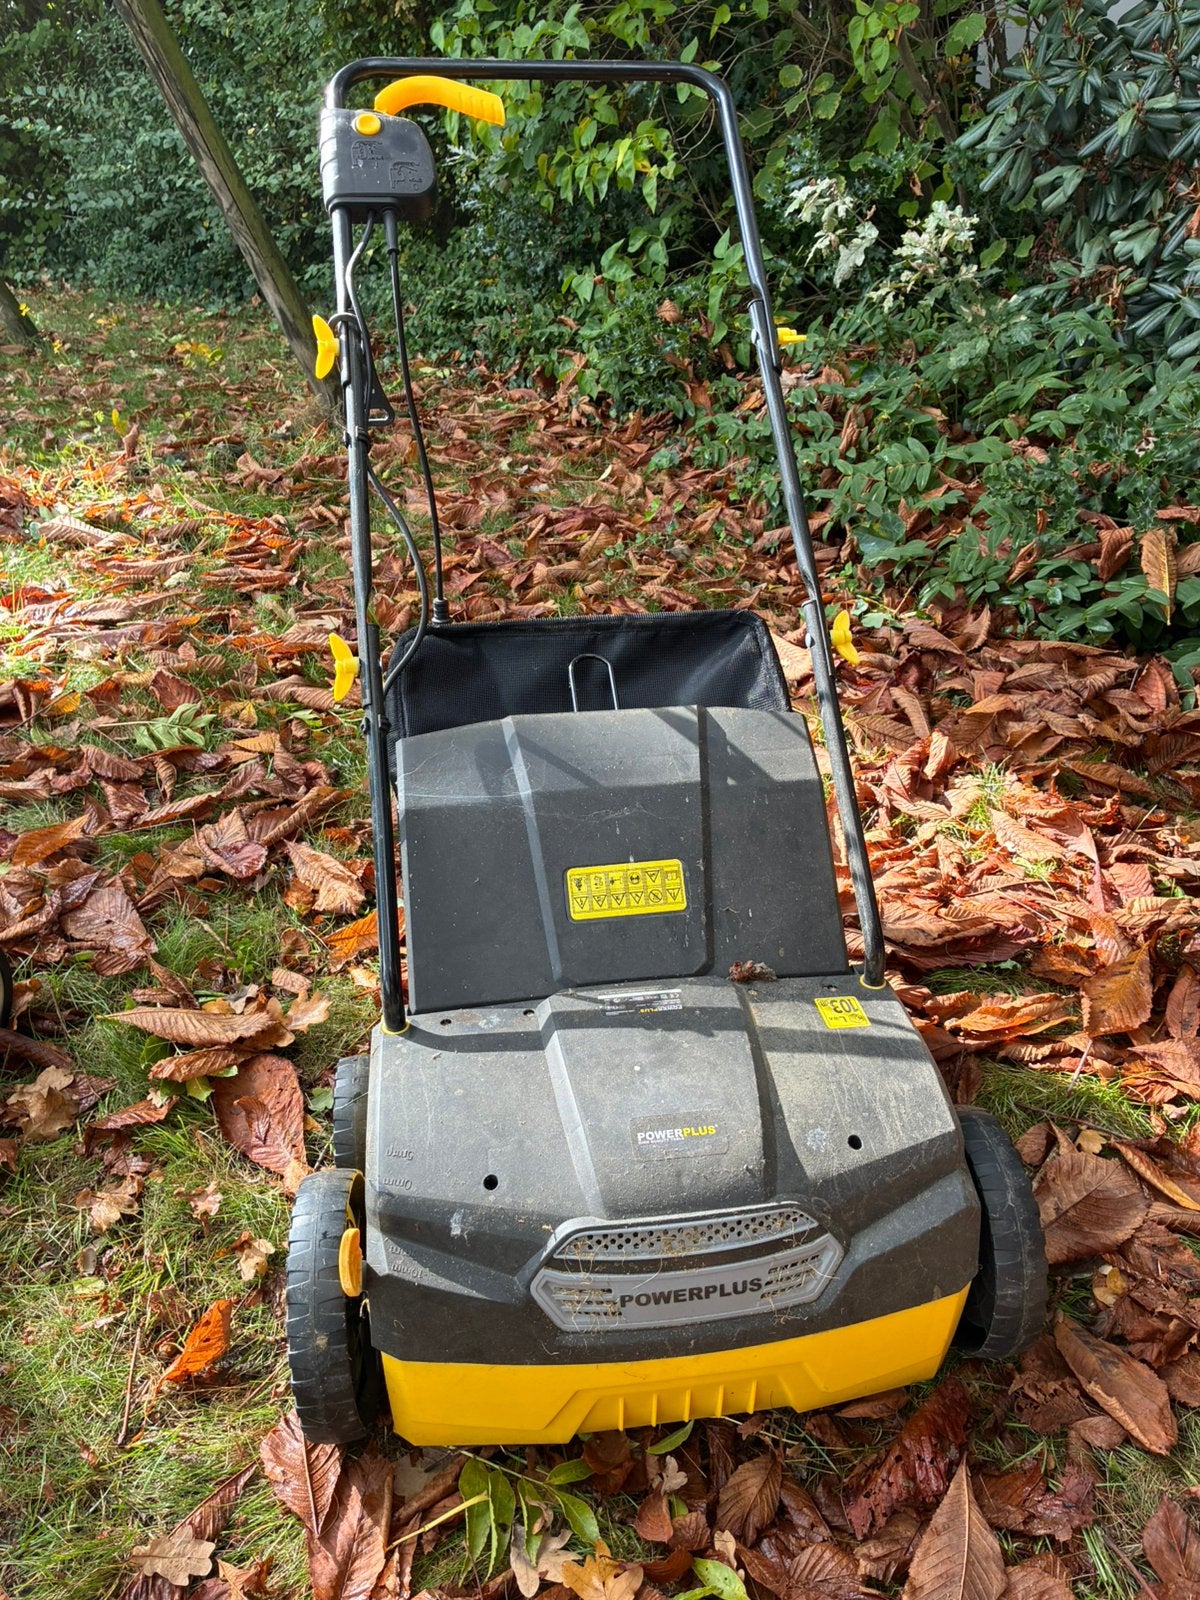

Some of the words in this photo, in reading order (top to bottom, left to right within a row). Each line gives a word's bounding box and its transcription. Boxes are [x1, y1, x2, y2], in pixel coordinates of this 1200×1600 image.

[829, 999, 859, 1014] 103
[637, 1125, 717, 1142] POWERPLUS
[619, 1277, 763, 1308] POWERPLUS
